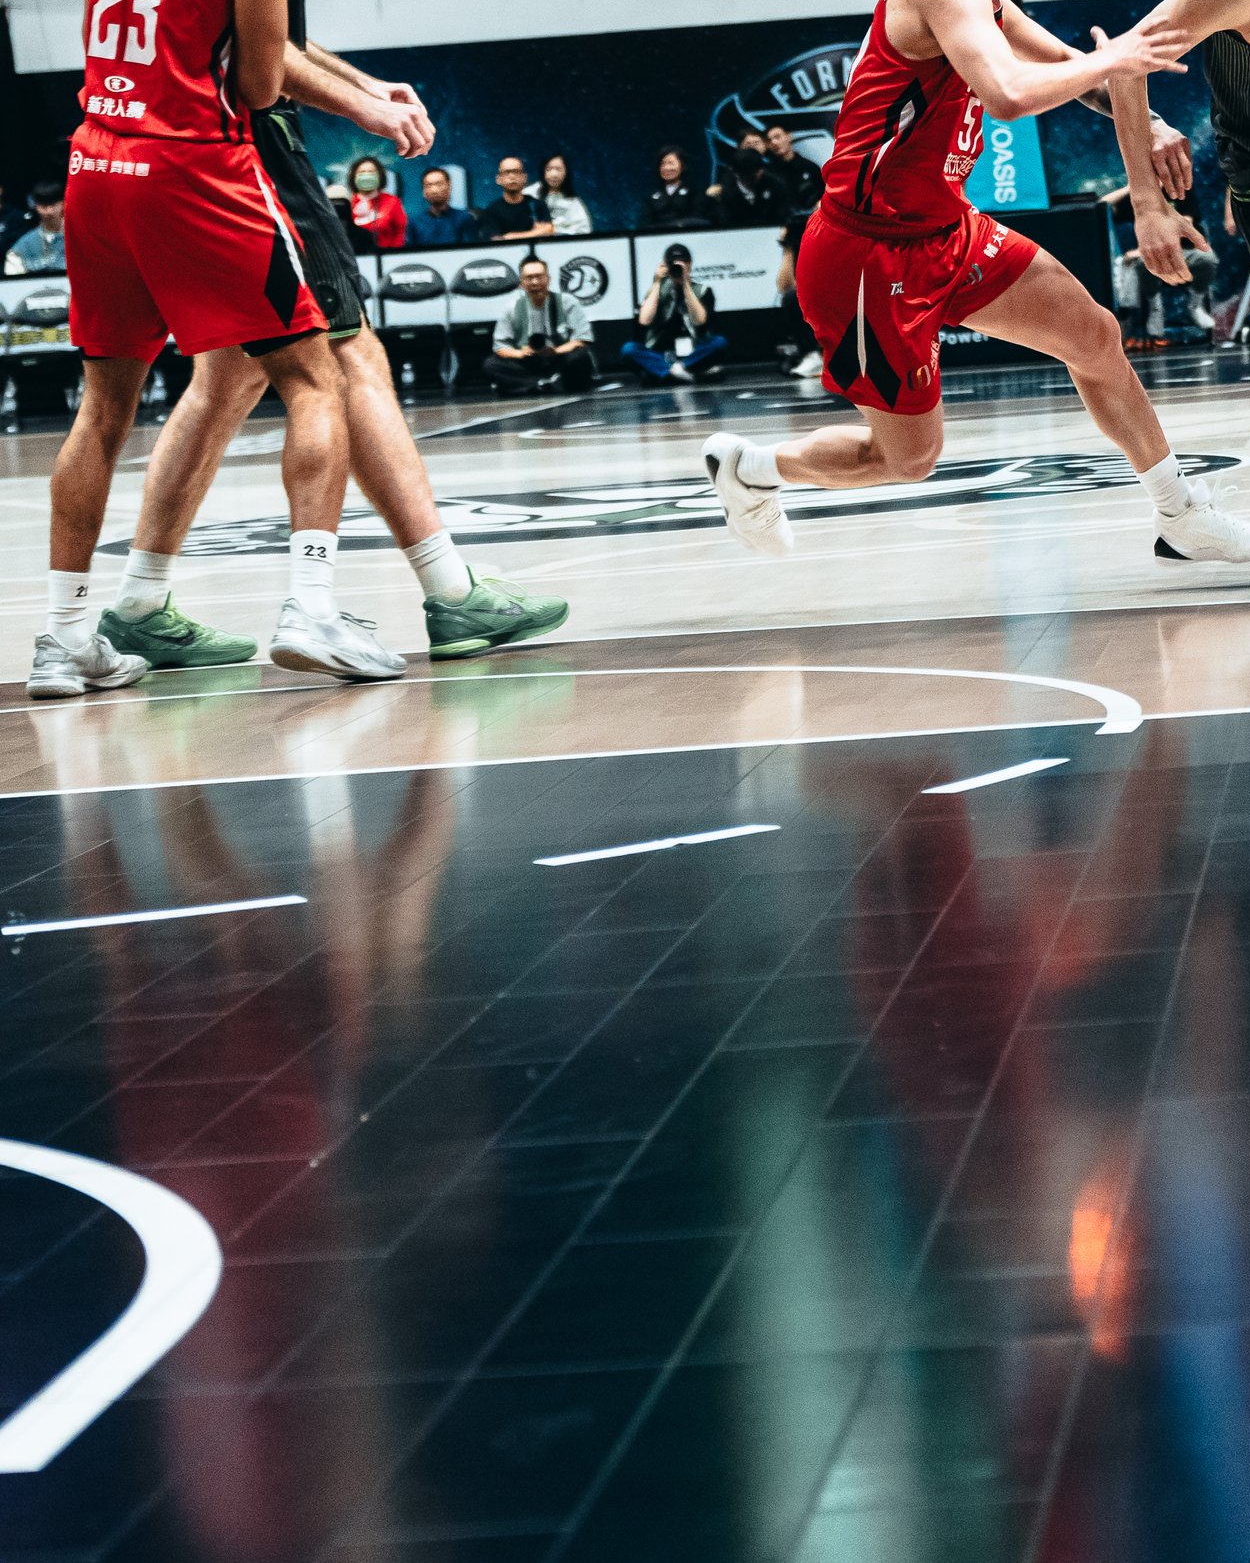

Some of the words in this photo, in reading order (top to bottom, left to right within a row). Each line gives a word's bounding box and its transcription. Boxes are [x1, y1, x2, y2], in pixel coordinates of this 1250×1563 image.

[86, 95, 147, 118] 新光人壽
[303, 545, 327, 559] 23
